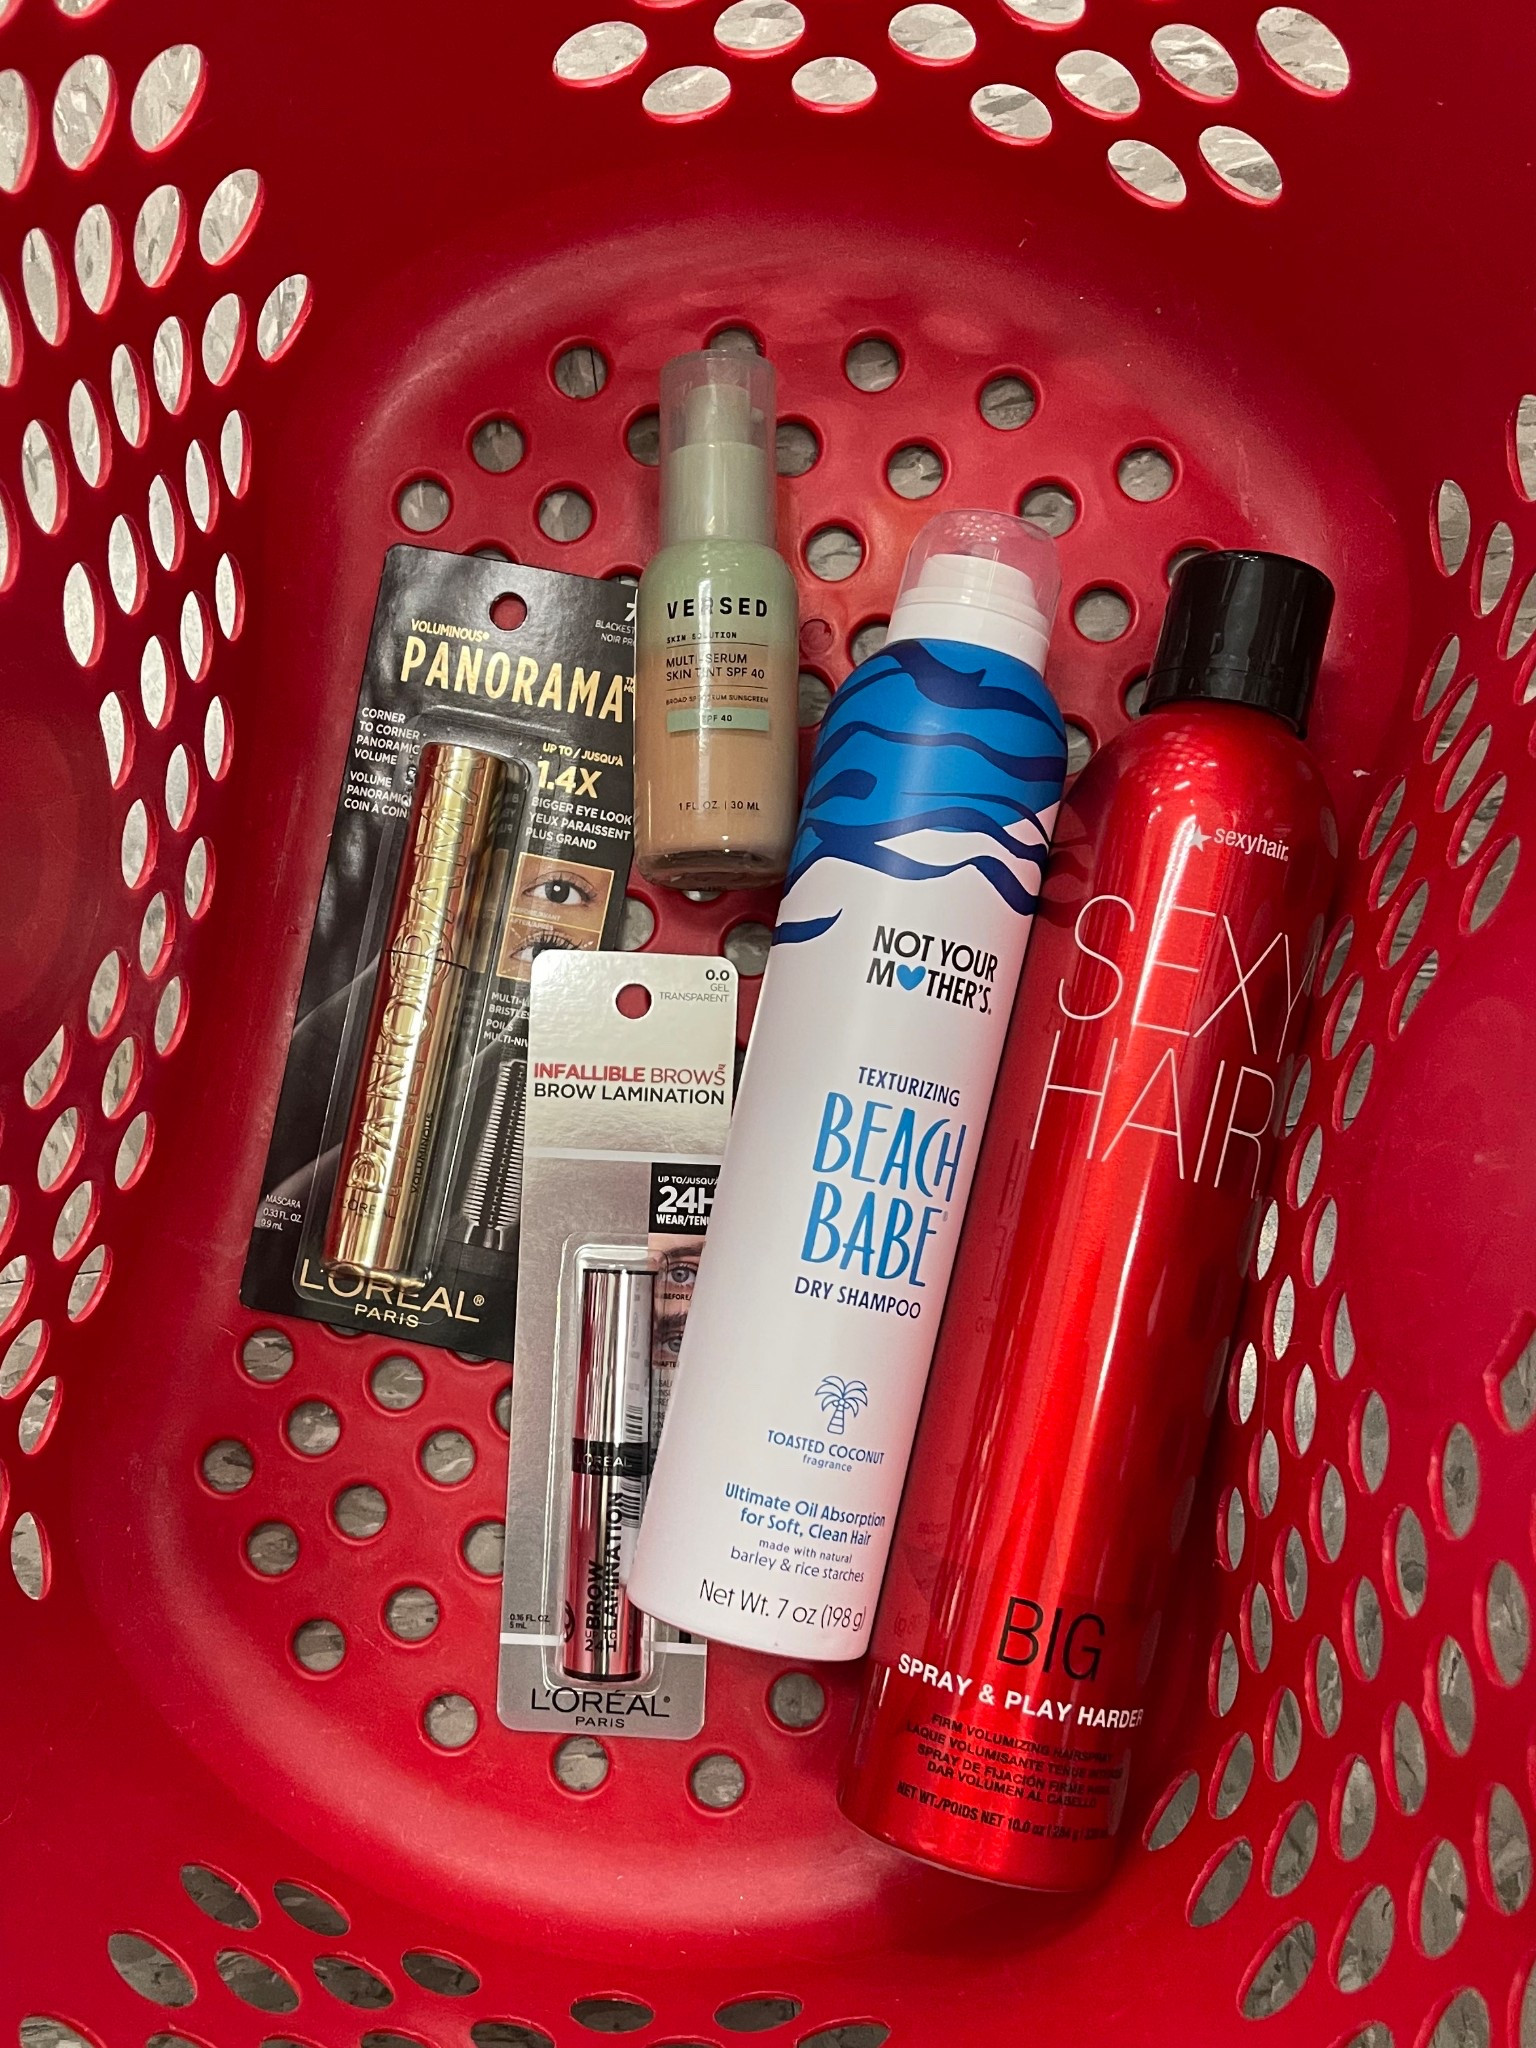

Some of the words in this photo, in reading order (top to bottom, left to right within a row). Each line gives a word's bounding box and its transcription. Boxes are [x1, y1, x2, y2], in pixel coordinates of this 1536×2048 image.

[667, 596, 768, 619] VERSED
[600, 632, 621, 644] NOIR
[667, 634, 686, 644] SKIN
[399, 636, 624, 723] PANORAMA
[666, 668, 692, 682] SKIN
[726, 666, 748, 678] SPF
[750, 668, 765, 680] 40
[666, 697, 688, 706] BROAD
[688, 694, 727, 702] SPCTRUM
[728, 694, 769, 703] SUNSCREEN
[361, 706, 406, 724] CORNER
[720, 714, 733, 722] 40
[359, 720, 374, 732] TO
[376, 724, 420, 740] CORNER
[354, 748, 398, 766] VOLUME
[356, 734, 420, 755] PANORAMIC
[542, 742, 558, 754] UP
[558, 745, 573, 756] TO
[581, 750, 624, 767] JUSQU'À
[350, 770, 393, 788] VOLUME
[537, 760, 602, 799] 1.4X
[344, 798, 370, 812] COIN
[371, 800, 380, 814] À
[381, 804, 408, 818] COIN
[531, 796, 574, 814] BIGGER
[575, 804, 599, 819] EYE
[600, 810, 633, 826] LOOK
[679, 802, 683, 811] 1
[730, 800, 744, 810] 30
[746, 802, 760, 811] ML
[526, 826, 554, 841] PLUS
[556, 834, 598, 850] GRAND
[528, 811, 560, 826] YEUX
[560, 818, 632, 841] PARAISSENT
[872, 925, 935, 963] NOT
[939, 938, 998, 983] YOUR
[710, 982, 730, 992] GEL
[1058, 894, 1318, 1063] SEXY
[490, 992, 530, 1007] MULTI-L
[659, 991, 730, 1003] TRANSPARENT
[486, 1018, 514, 1032] POILS
[534, 1062, 646, 1083] INFALLIBLE
[650, 1068, 726, 1086] BROWS
[858, 1066, 961, 1107] TEXTURIZING
[534, 1082, 597, 1100] BROW
[601, 1084, 724, 1105] LAMINATION
[1030, 1029, 1276, 1199] HAIR
[812, 1091, 967, 1202] BEACH
[265, 1194, 301, 1209] MASCARA
[656, 1214, 710, 1226] WEAR/TEN
[801, 1181, 943, 1287] BABE
[794, 1276, 834, 1300] DRY
[836, 1286, 922, 1319] SHAMPOO
[354, 1303, 419, 1328] PARIS
[768, 1430, 824, 1454] TOASTED
[829, 1444, 885, 1465] COCONUT
[802, 1454, 853, 1472] fragrance
[724, 1482, 790, 1512] Ultimate
[795, 1499, 818, 1518] Oil
[820, 1504, 886, 1529] Absorption
[740, 1508, 764, 1526] for
[766, 1514, 804, 1538] Soft,
[808, 1524, 848, 1544] Clean
[850, 1530, 872, 1546] Hair
[603, 1492, 624, 1631] LAMINATION
[758, 1538, 790, 1554] made
[793, 1544, 817, 1559] with
[820, 1549, 852, 1564] natural
[730, 1546, 777, 1572] barley
[780, 1558, 792, 1572] &
[794, 1562, 820, 1578] rice
[822, 1566, 864, 1582] starches
[586, 1560, 604, 1630] BROW
[699, 1578, 736, 1608] Net
[740, 1589, 770, 1617] Wt.
[777, 1598, 789, 1619] 7
[792, 1606, 818, 1626] oz
[820, 1604, 850, 1630] (198
[516, 1622, 528, 1630] mL
[584, 1639, 617, 1652] 24H
[996, 1596, 1106, 1683] BIG
[898, 1653, 973, 1697] SPRAY
[978, 1683, 996, 1706] &
[1004, 1690, 1073, 1723] PLAY
[1077, 1706, 1145, 1729] HARDER
[576, 1716, 625, 1728] PARIS
[932, 1713, 964, 1733] FIRM
[966, 1724, 1050, 1756] VOLUMIZING
[906, 1720, 946, 1745] LAQUE
[948, 1736, 1044, 1772] VOLUMISANTE
[1048, 1761, 1086, 1778] TENUE
[917, 1743, 960, 1766] SPRAY
[962, 1759, 982, 1774] DE
[1048, 1781, 1086, 1795] FIRME
[927, 1760, 954, 1778] DAR
[958, 1771, 1024, 1799] VOLUMEN
[1027, 1790, 1044, 1803] AL
[896, 1780, 919, 1799] NET
[980, 1810, 1005, 1827] NET
[1008, 1817, 1031, 1834] 10.0
[1032, 1824, 1045, 1835] oz
